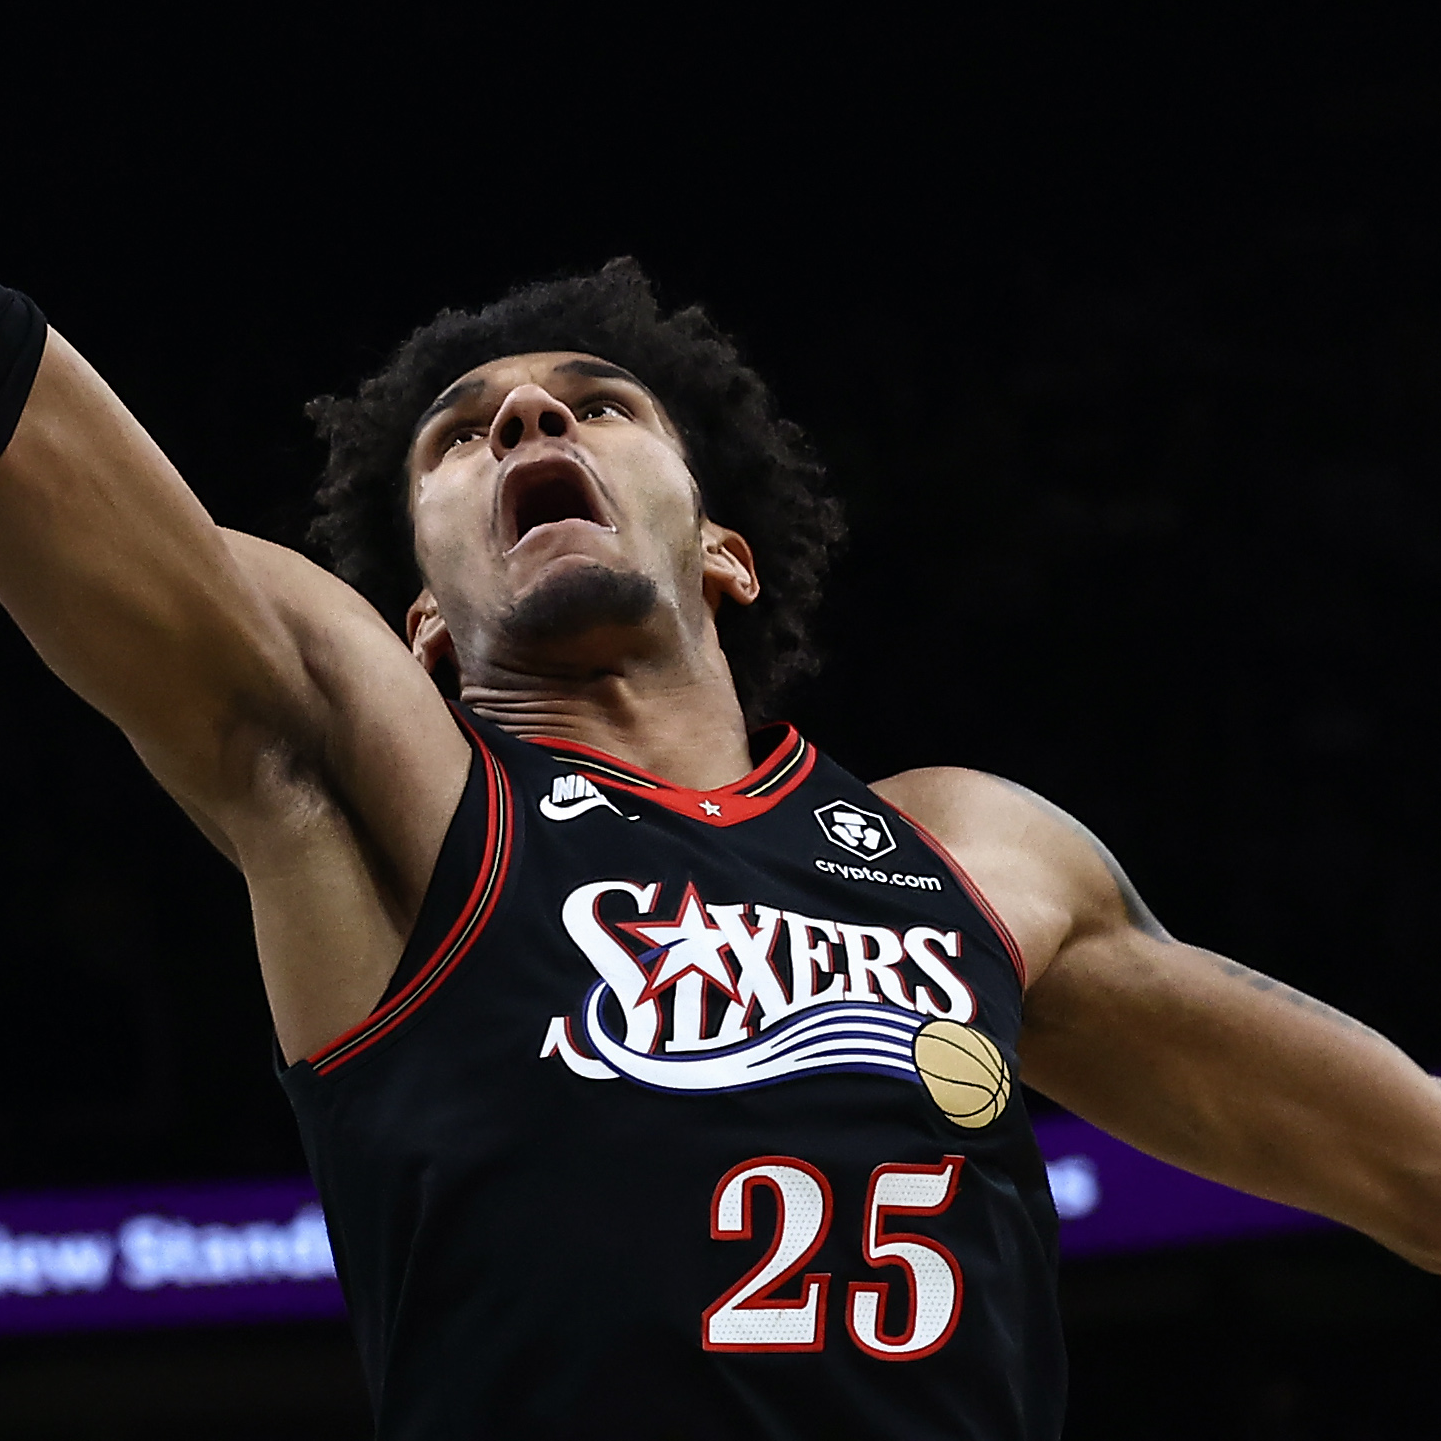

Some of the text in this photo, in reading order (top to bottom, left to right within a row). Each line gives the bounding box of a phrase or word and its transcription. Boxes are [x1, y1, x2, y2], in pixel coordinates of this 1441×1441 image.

[814, 859, 942, 891] crypto.com
[121, 1202, 336, 1290] Stand
[702, 1154, 966, 1360] 25
